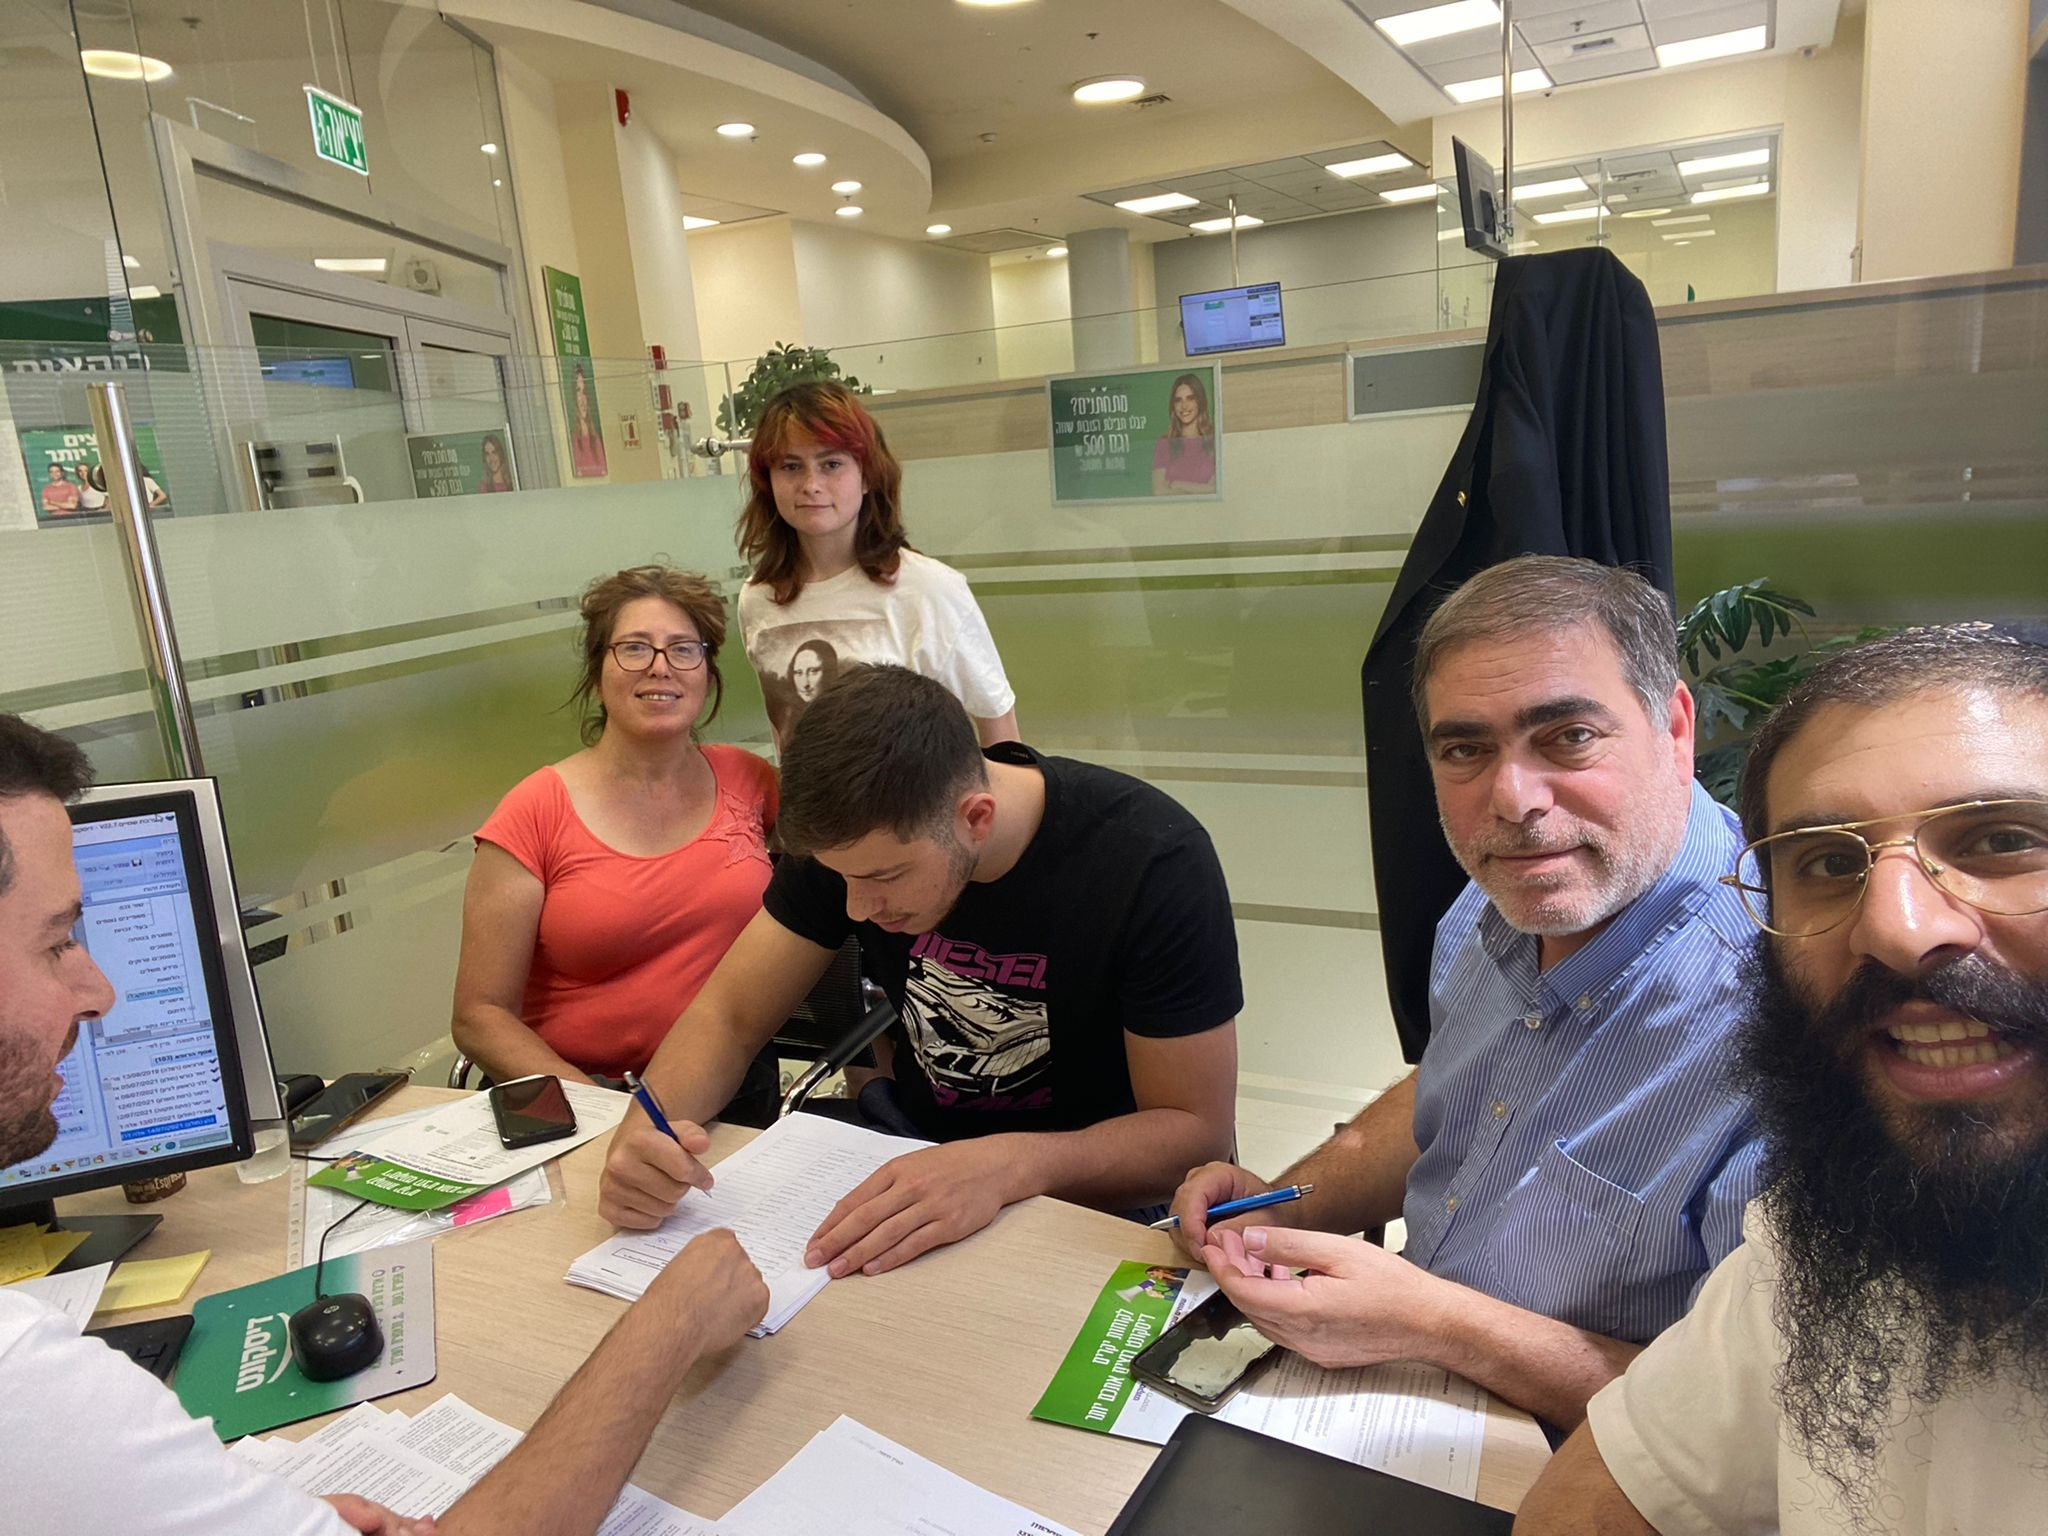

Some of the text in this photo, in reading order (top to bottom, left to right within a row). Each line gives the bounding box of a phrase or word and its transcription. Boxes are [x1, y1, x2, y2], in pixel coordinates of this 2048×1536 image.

[1092, 1308, 1134, 1365] לקוחות יקרים
[1125, 1313, 1156, 1348] דיסקונט
[235, 1314, 277, 1393] דיסקונט
[1098, 1375, 1125, 1402] אתכם
[1085, 1403, 1108, 1420] יותר
